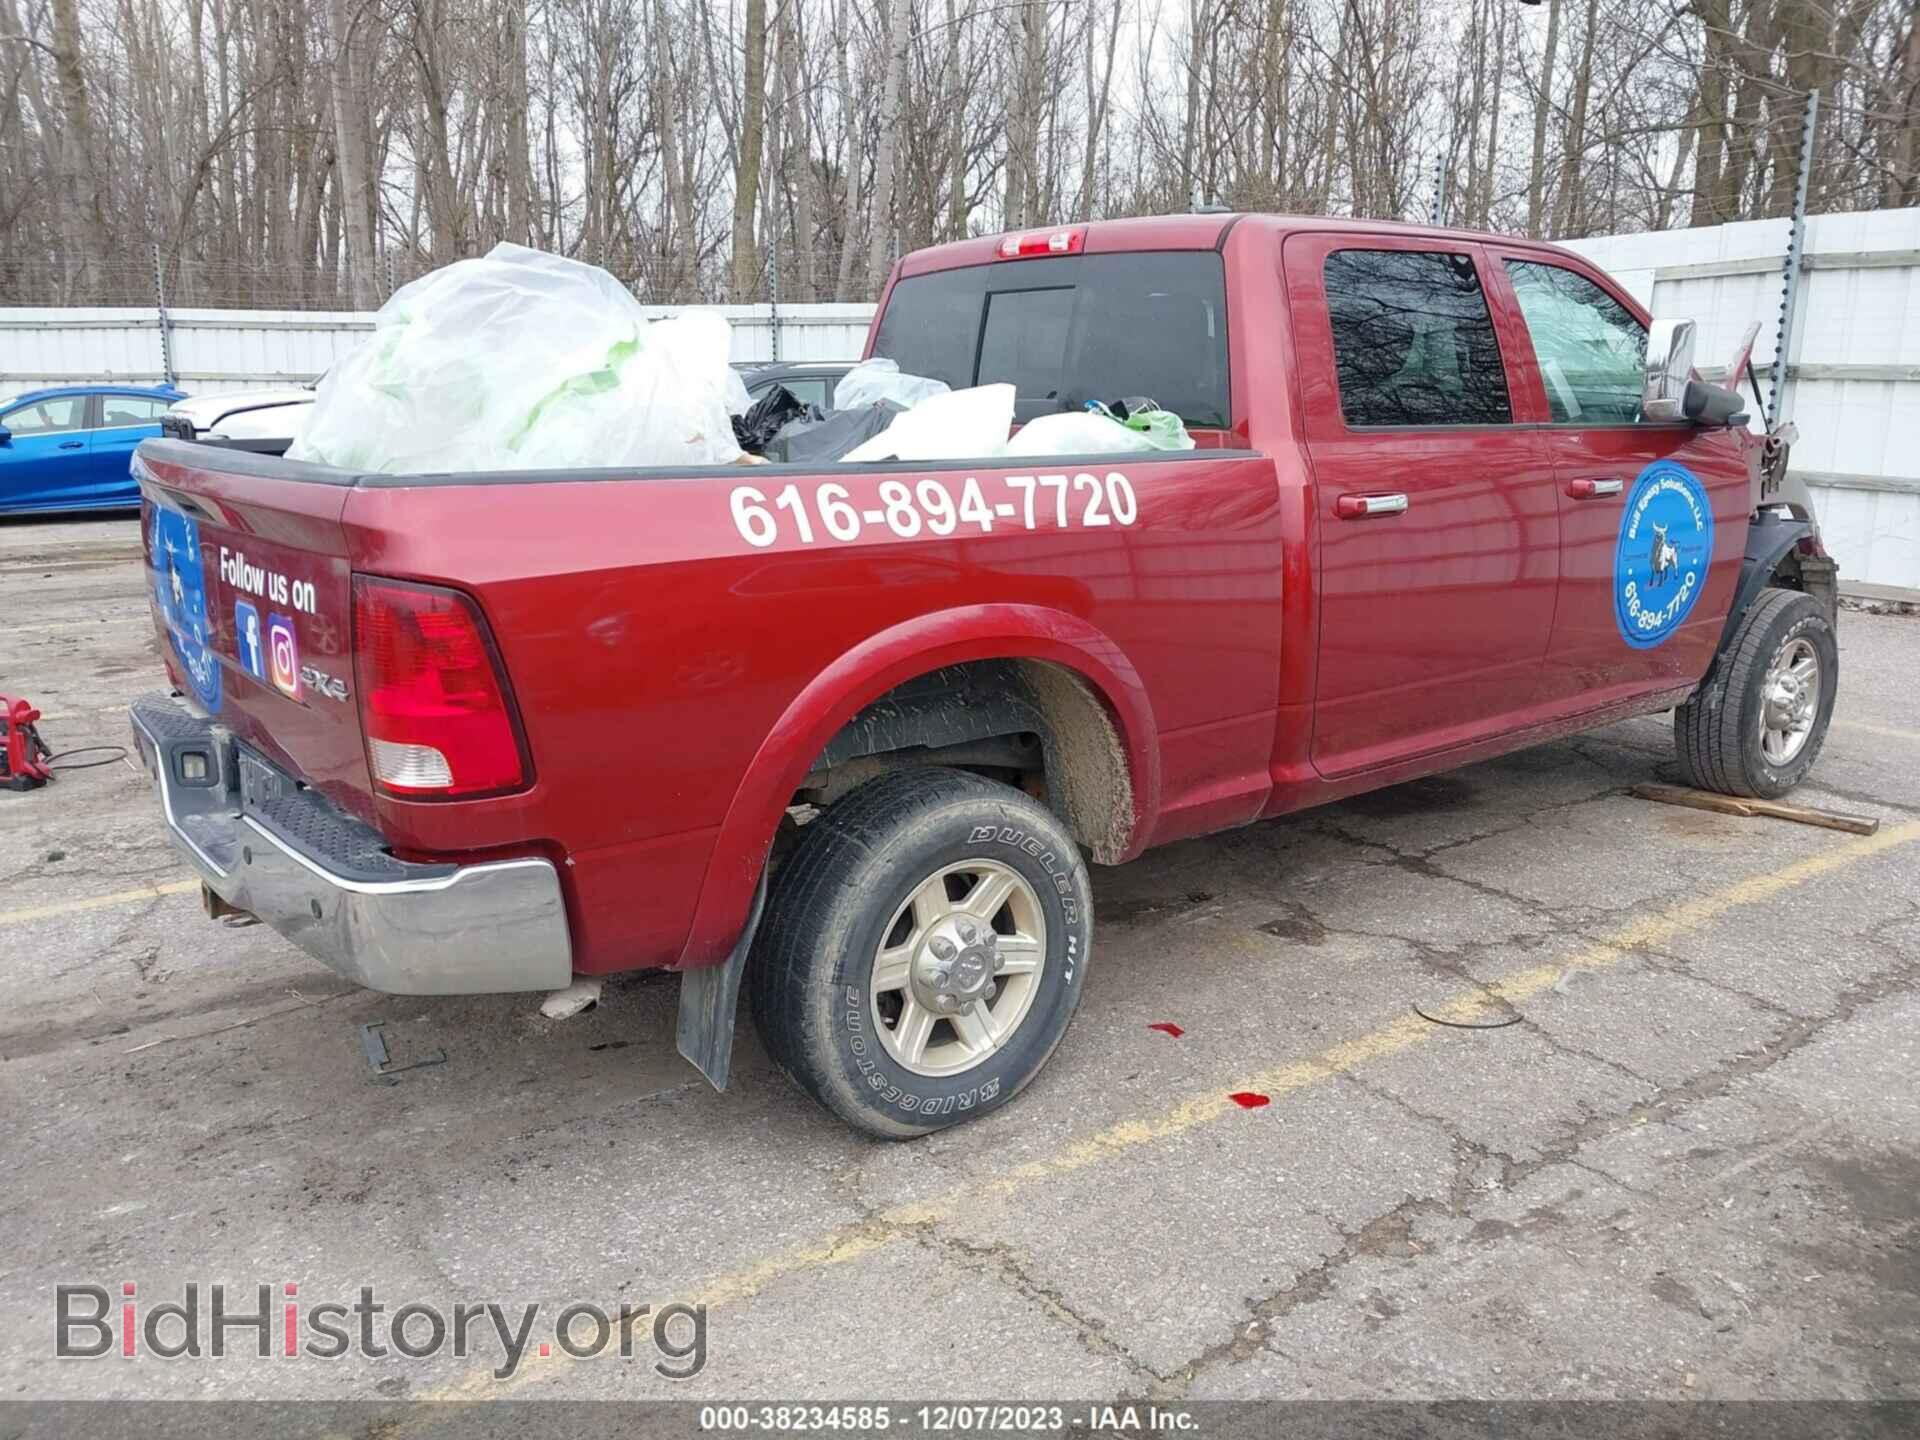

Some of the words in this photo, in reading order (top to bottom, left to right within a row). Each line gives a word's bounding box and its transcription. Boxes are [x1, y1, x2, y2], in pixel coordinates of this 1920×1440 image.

[729, 471, 1138, 548] 616-894-7720
[219, 546, 265, 596] Follow
[268, 572, 288, 605] us
[292, 578, 316, 614] on
[1625, 572, 1696, 630] 616-894-7720
[968, 825, 1080, 926] DUELER
[1063, 934, 1077, 985] H/T
[844, 983, 1001, 1116] BRIDGESTONE
